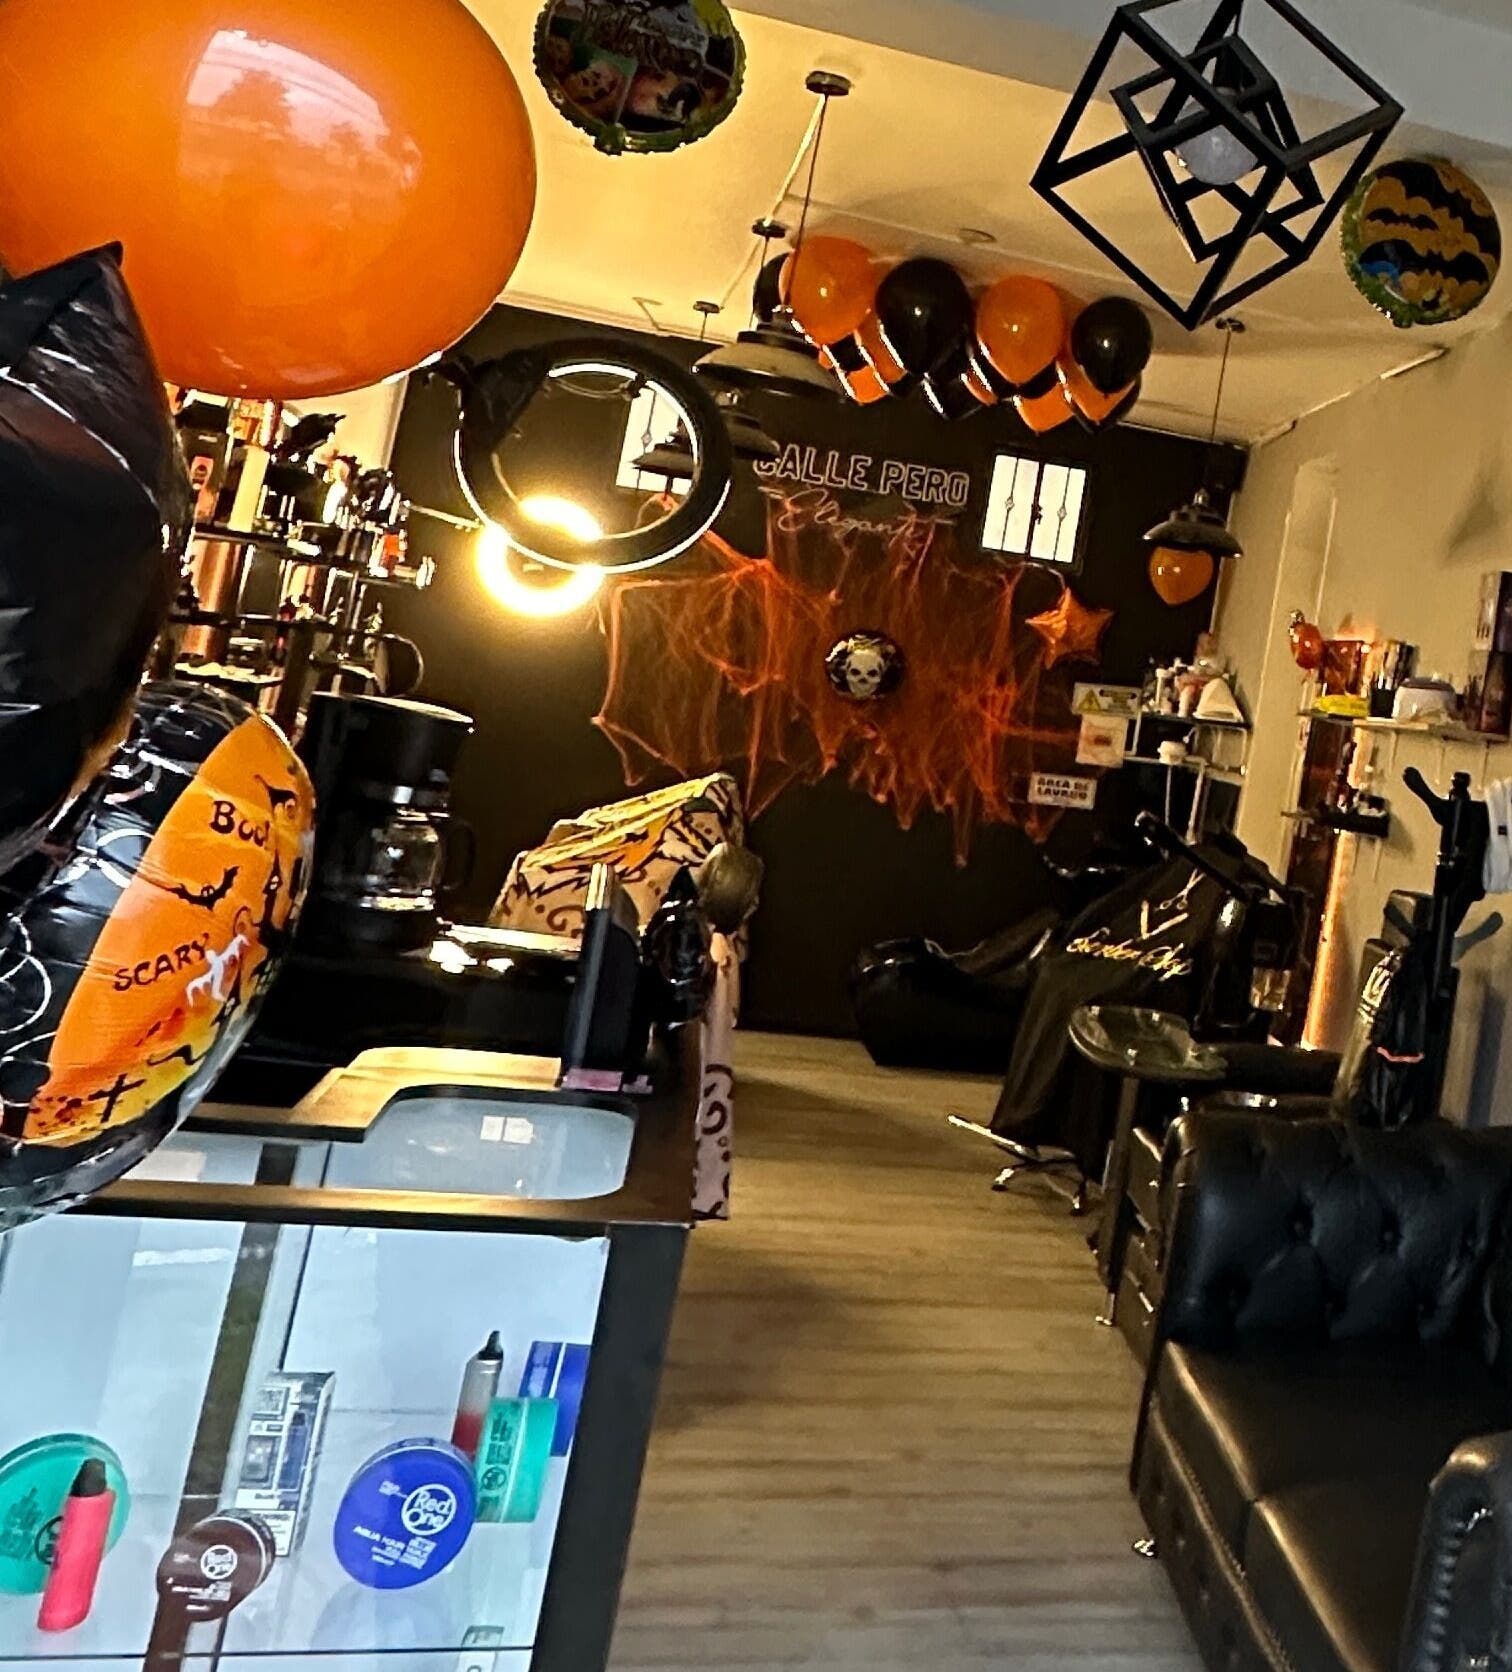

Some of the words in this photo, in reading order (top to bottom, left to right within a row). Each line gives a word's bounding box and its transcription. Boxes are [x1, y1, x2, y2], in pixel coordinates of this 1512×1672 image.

[879, 460, 969, 506] PERO
[778, 487, 956, 548] Elegant
[113, 932, 210, 991] SCARY
[408, 1508, 445, 1528] One
[413, 1489, 451, 1515] Red
